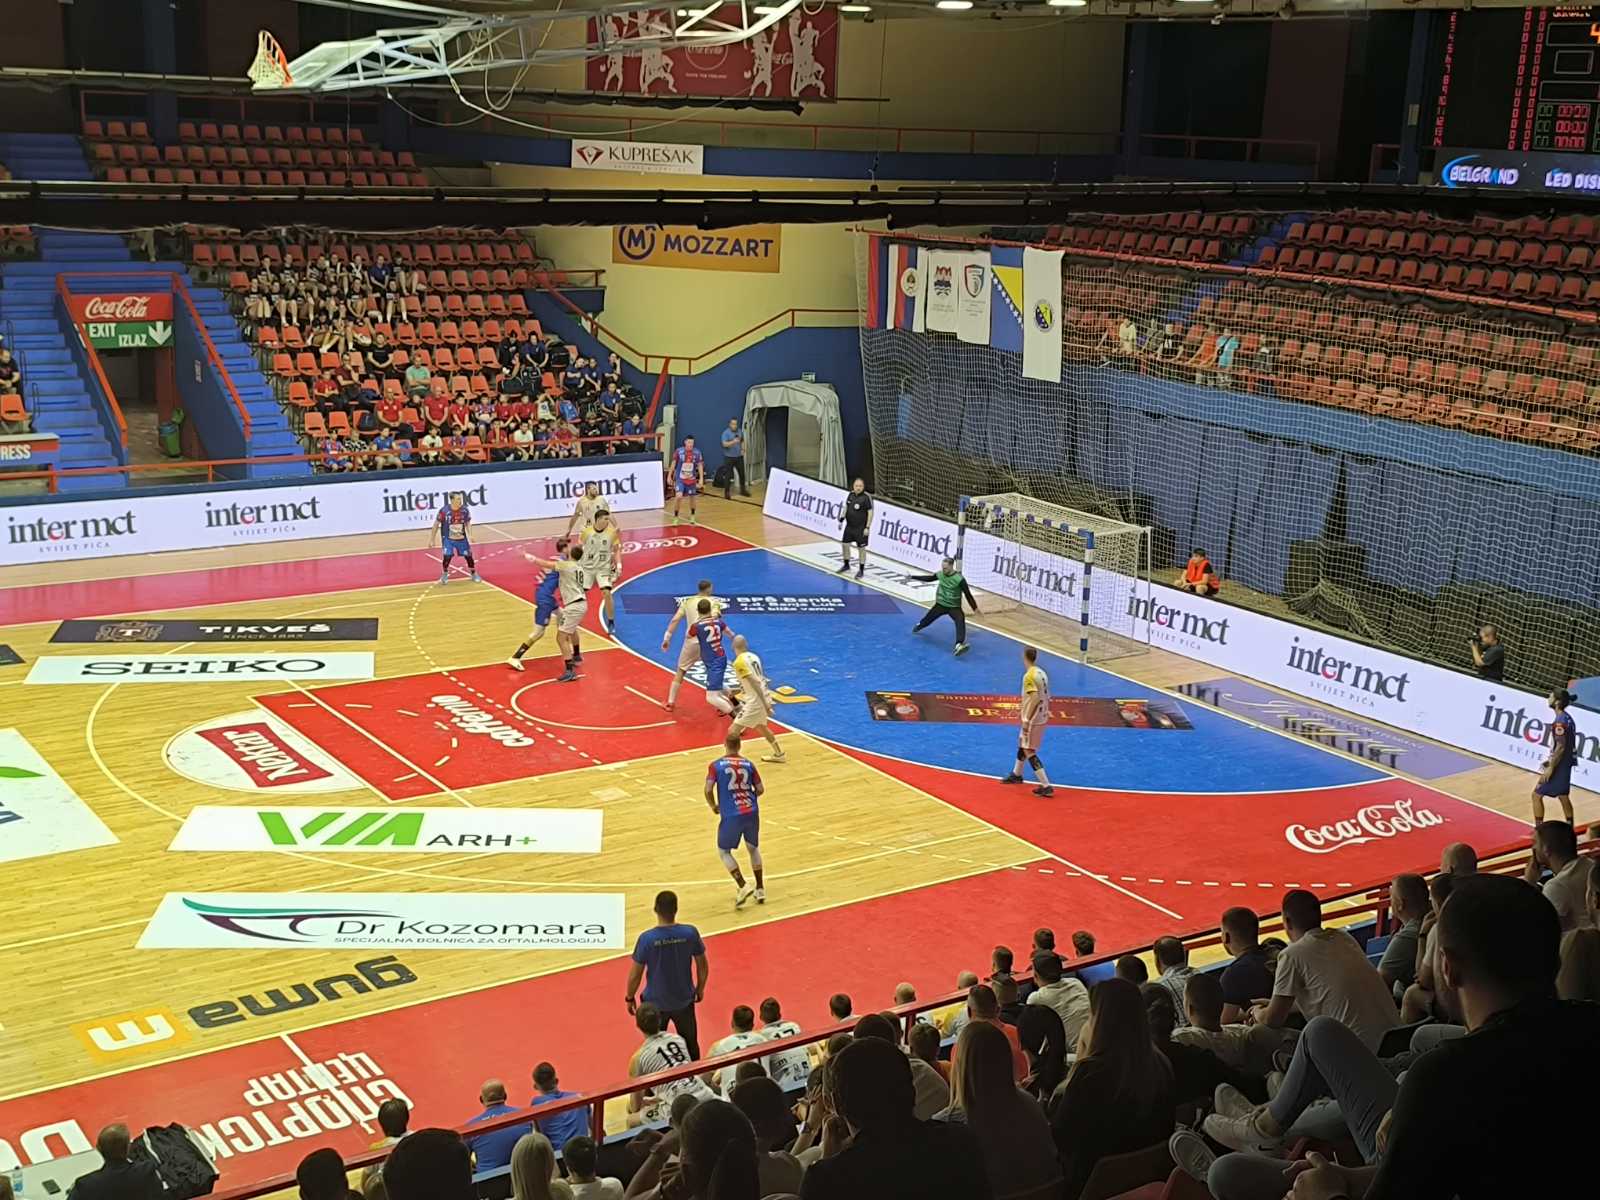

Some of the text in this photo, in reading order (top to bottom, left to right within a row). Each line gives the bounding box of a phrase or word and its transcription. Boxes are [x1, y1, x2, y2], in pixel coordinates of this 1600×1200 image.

[609, 145, 694, 165] KUPREŠAK
[1545, 170, 1572, 188] LED
[663, 233, 773, 258] MOZZART
[88, 322, 117, 338] EXIT
[118, 334, 147, 347] IZLAZ
[199, 622, 331, 635] TIKVEŠ
[80, 659, 326, 677] SEIKO
[223, 730, 309, 782] Nektar
[725, 767, 750, 790] 22
[337, 920, 606, 935] Dr Kozomara
[186, 954, 418, 1030] guma
